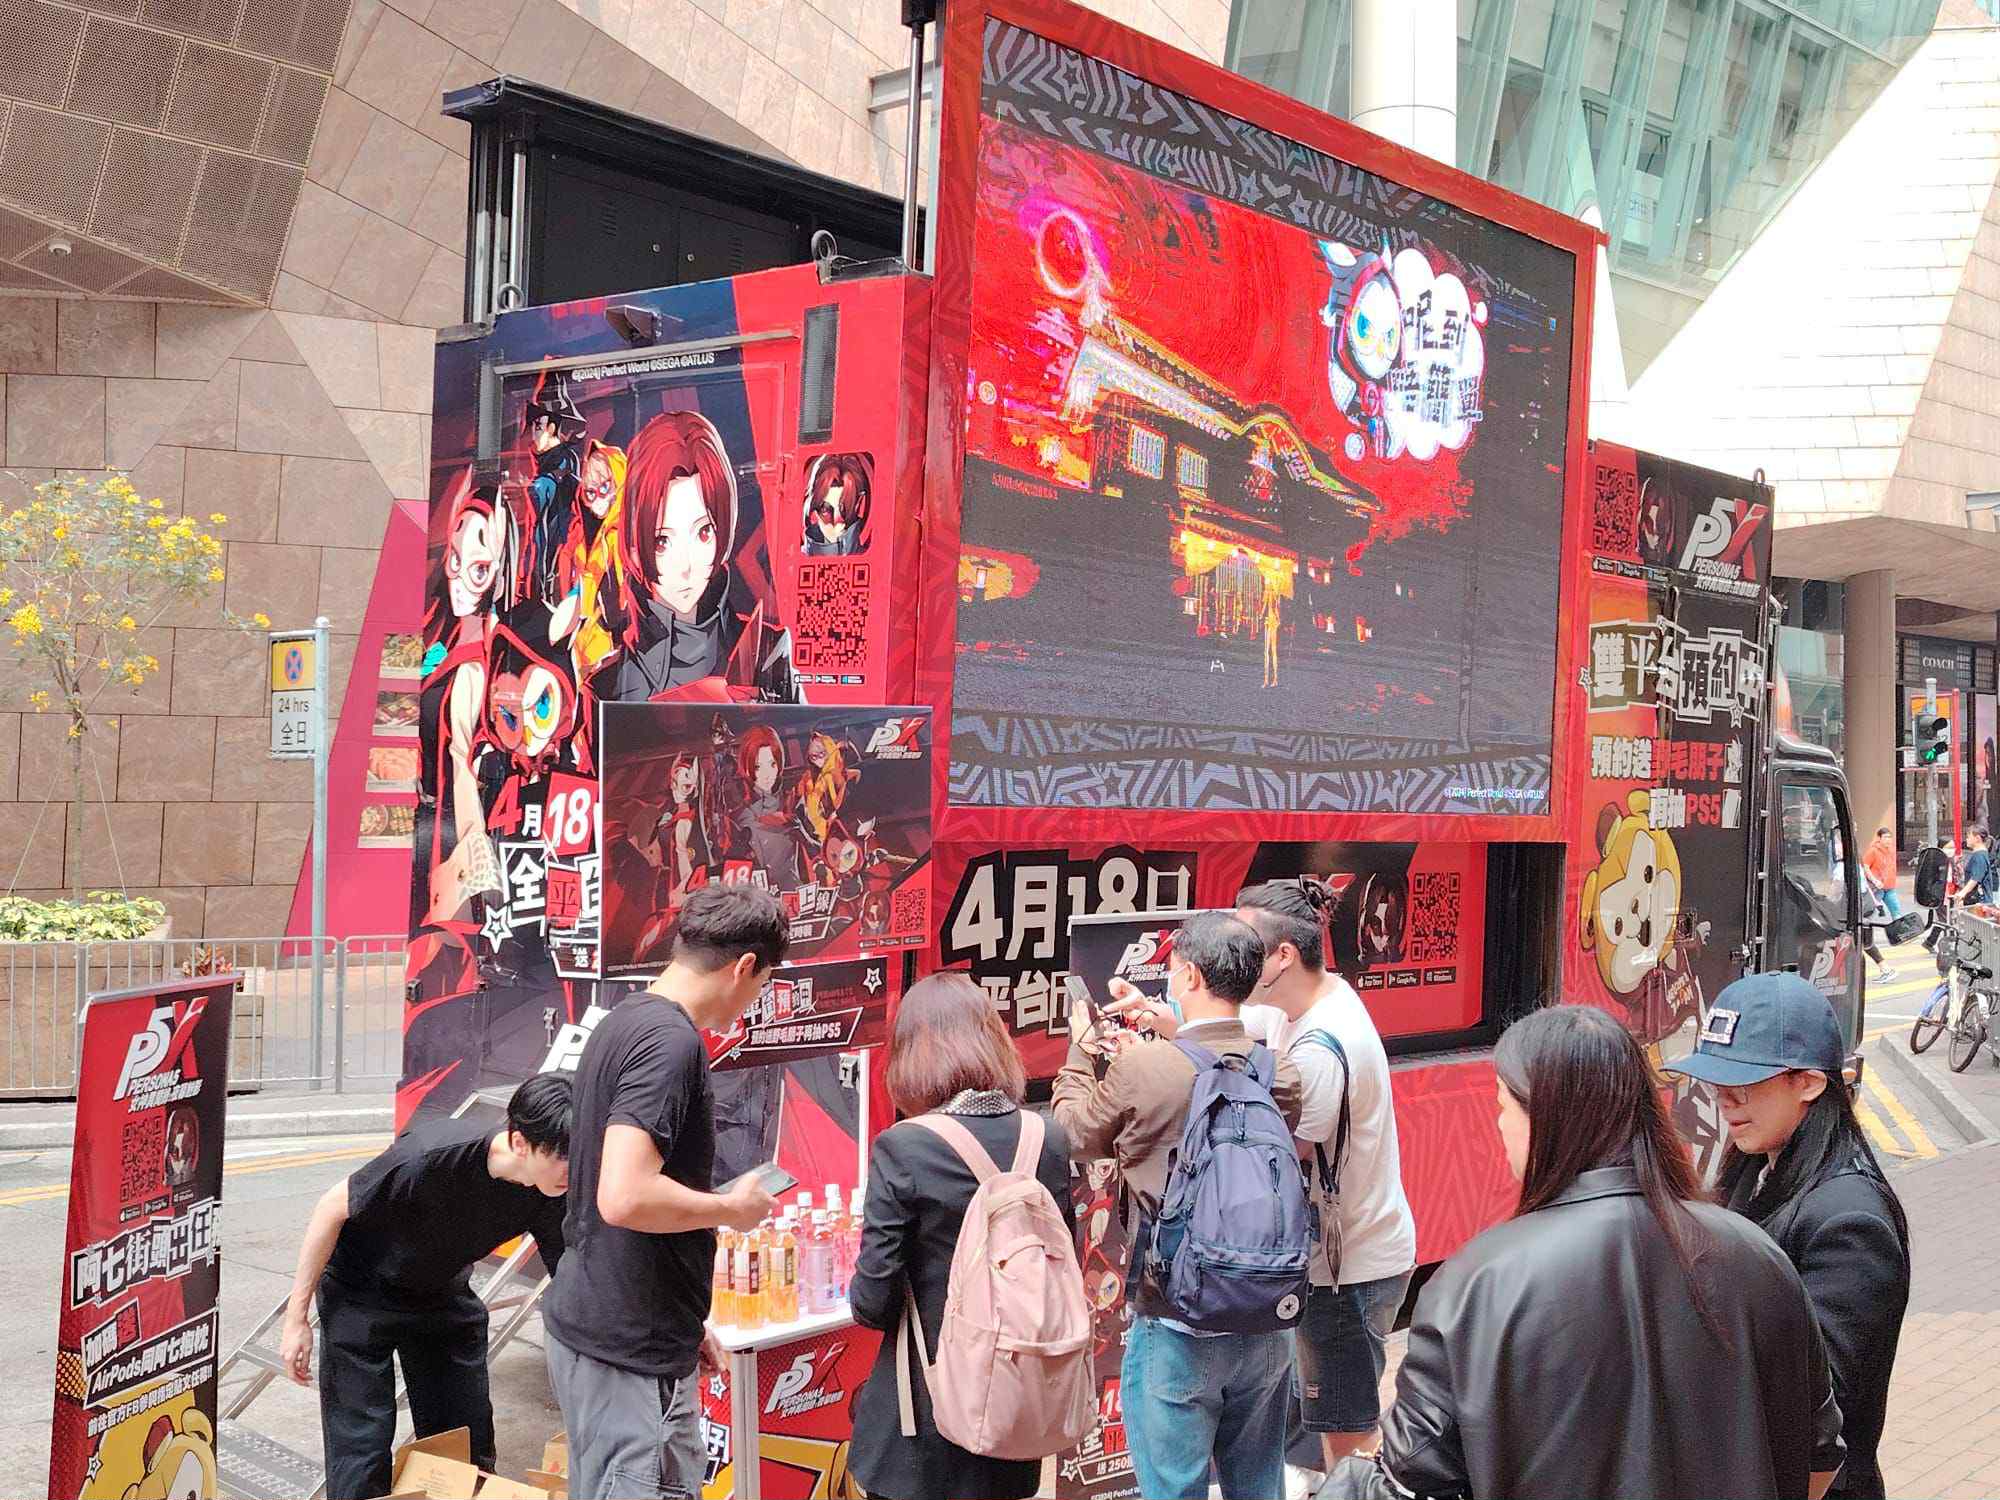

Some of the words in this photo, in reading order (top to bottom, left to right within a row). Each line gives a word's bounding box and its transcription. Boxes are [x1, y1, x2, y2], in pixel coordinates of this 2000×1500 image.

[601, 364, 627, 377] Perfect
[628, 361, 650, 374] World
[1922, 656, 1954, 670] COACH
[279, 698, 291, 713] 24
[293, 697, 309, 713] hrs
[281, 721, 306, 745] 全日
[487, 774, 599, 849] 4月18
[952, 857, 1191, 961] 4月18日
[113, 996, 209, 1101] P5X
